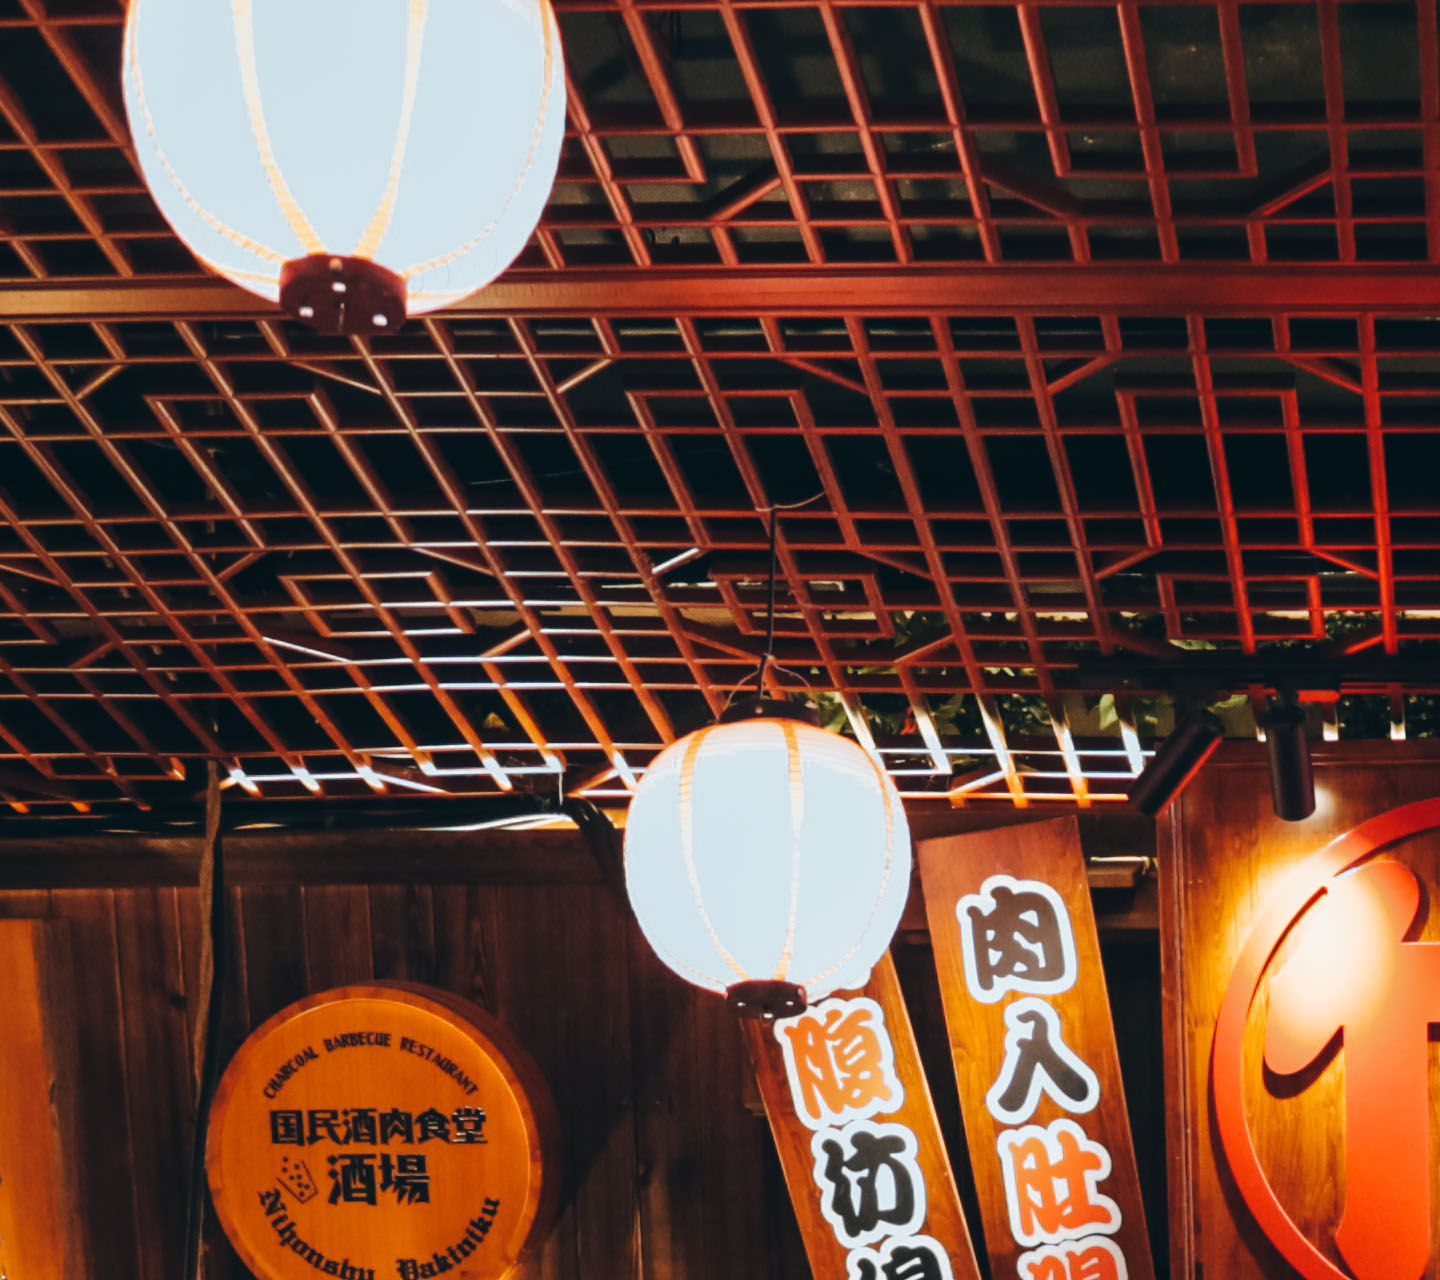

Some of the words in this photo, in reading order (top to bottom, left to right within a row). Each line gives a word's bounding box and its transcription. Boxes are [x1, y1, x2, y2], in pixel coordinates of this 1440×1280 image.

[263, 1046, 319, 1099] CHARCOAL
[323, 1032, 392, 1052] BARBECUE
[399, 1036, 478, 1096] RESTAURANT
[269, 1106, 488, 1147] 国民酒肉食堂
[327, 1153, 430, 1206] 酒場
